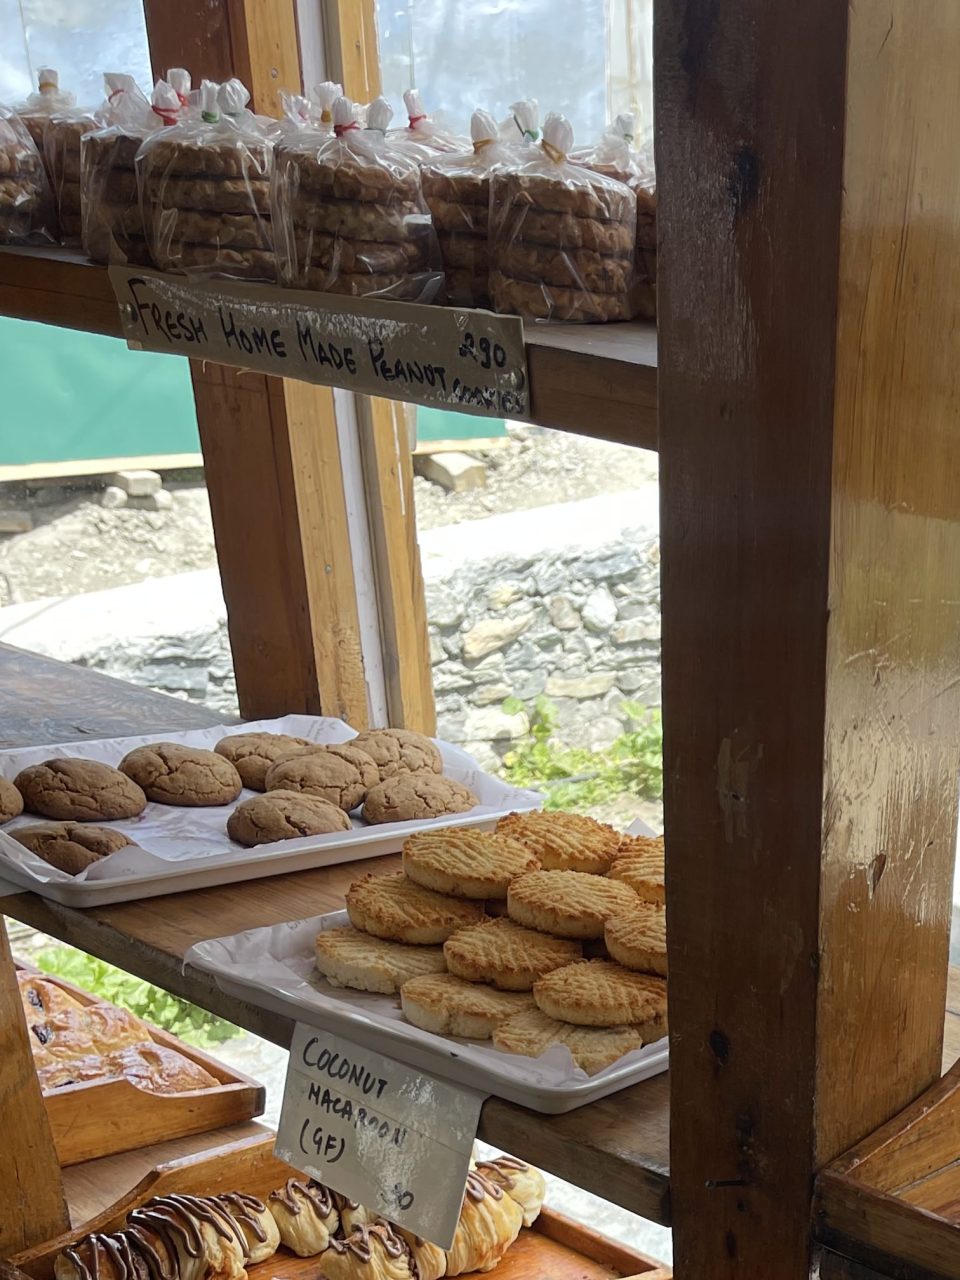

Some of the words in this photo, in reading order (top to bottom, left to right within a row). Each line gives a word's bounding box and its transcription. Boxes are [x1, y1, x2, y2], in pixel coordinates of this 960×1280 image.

[127, 277, 206, 343] FRESH
[220, 308, 287, 359] HOME
[297, 319, 357, 375] MADE
[368, 338, 447, 391] PEANUT
[302, 1037, 388, 1098] COCONUT
[300, 1118, 346, 1163] (GF)
